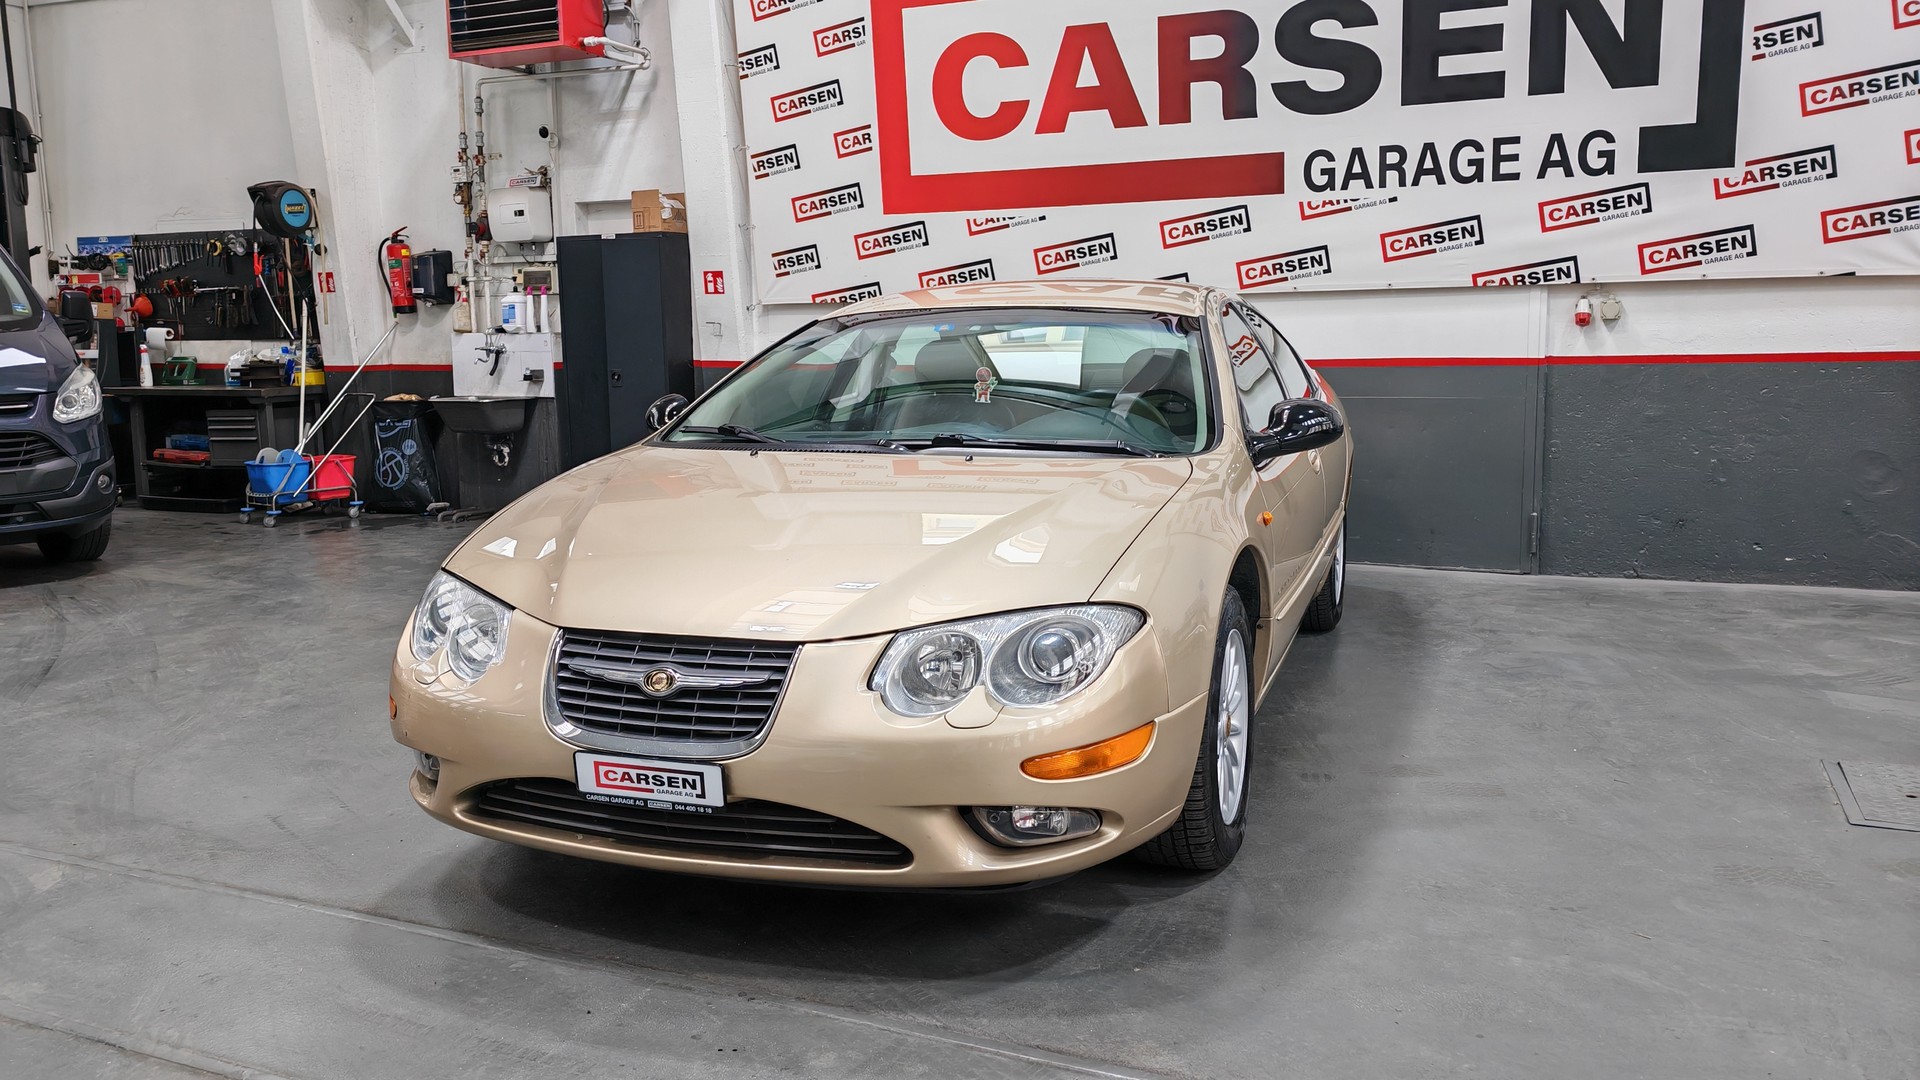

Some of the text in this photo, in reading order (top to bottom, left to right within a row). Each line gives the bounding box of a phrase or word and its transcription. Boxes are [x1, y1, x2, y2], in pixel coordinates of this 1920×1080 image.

[1768, 46, 1798, 58] GARAGE
[932, 0, 1663, 141] CARSEN
[1810, 70, 1919, 105] CARSEN
[1872, 92, 1904, 104] GARAGE
[778, 88, 838, 113] CARSEN
[1303, 129, 1616, 192] GARAGE AG
[1782, 177, 1812, 188] GARAGE
[798, 191, 857, 214] CARSEN
[1354, 201, 1377, 211] GARAGE
[1548, 192, 1643, 222] CARSEN
[1168, 213, 1244, 240] CARSEN
[1602, 211, 1629, 222] GARAGE
[861, 229, 922, 252] CARSEN
[1211, 231, 1233, 240] GARAGE
[1389, 224, 1476, 253] CARSEN
[1042, 241, 1110, 266] CARSEN
[1438, 243, 1463, 253] GARAGE
[1648, 235, 1748, 265] CARSEN
[1704, 254, 1733, 265] GARAGE
[1245, 254, 1324, 280] CARSEN
[1290, 272, 1312, 281] GARAGE
[603, 769, 697, 790] CARSEN
[586, 794, 610, 802] CARSEN
[610, 797, 635, 805] GARAGE
